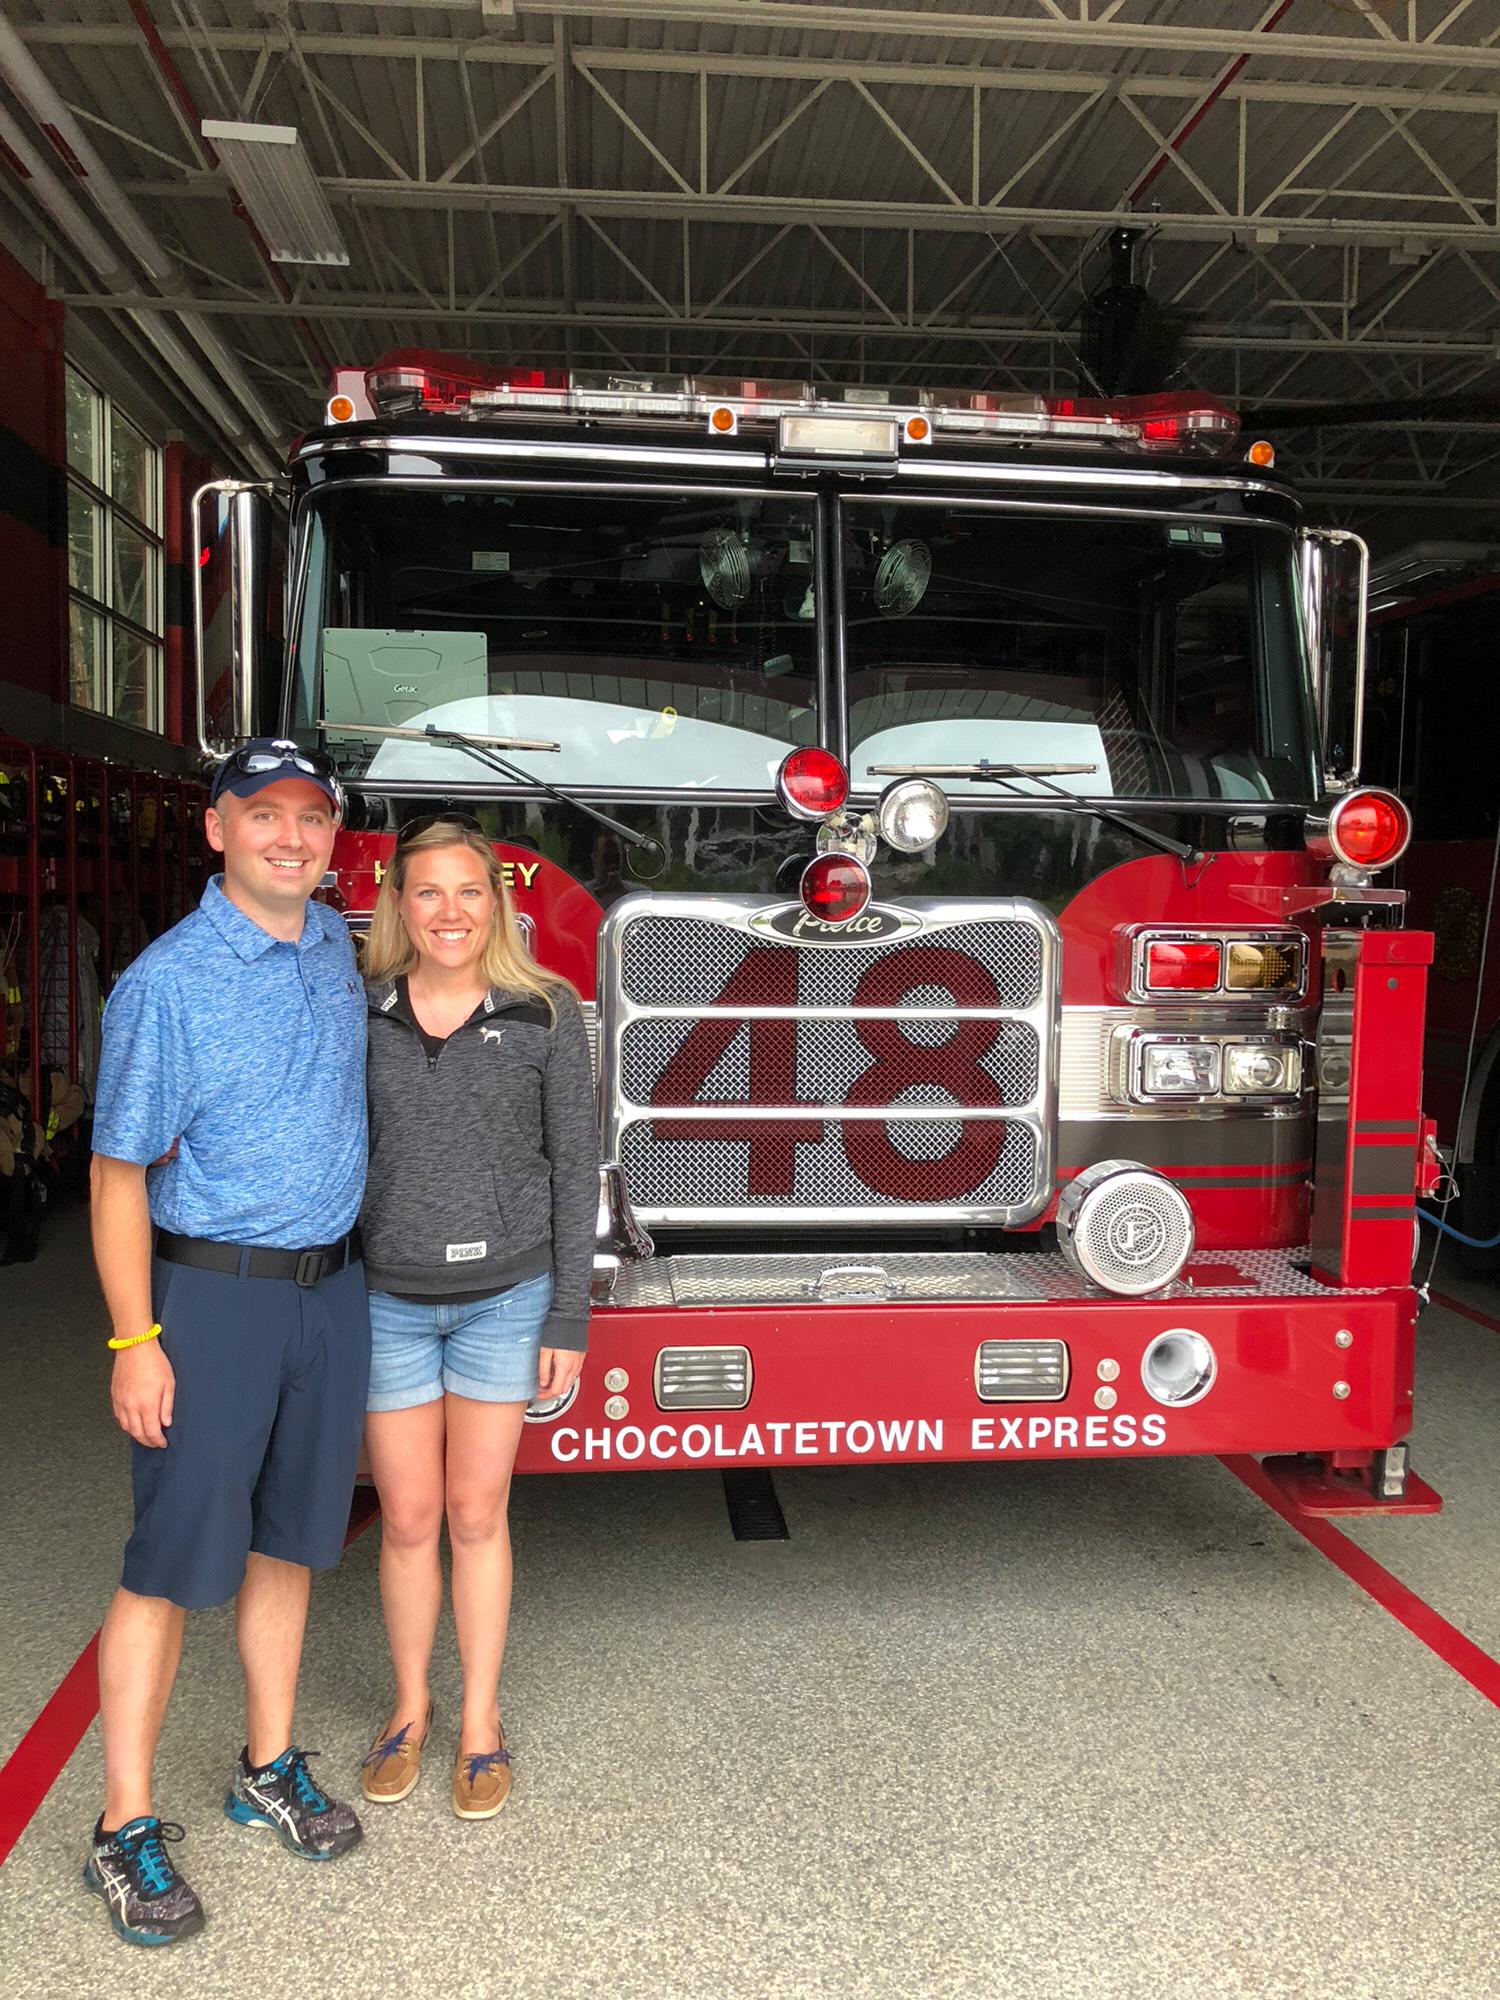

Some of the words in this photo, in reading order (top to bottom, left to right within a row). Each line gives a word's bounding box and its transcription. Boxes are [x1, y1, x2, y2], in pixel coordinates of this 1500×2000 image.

[650, 946, 1007, 1201] 48
[551, 1419, 944, 1462] CHOCOLATETOWN
[971, 1414, 1167, 1450] EXPRESS
